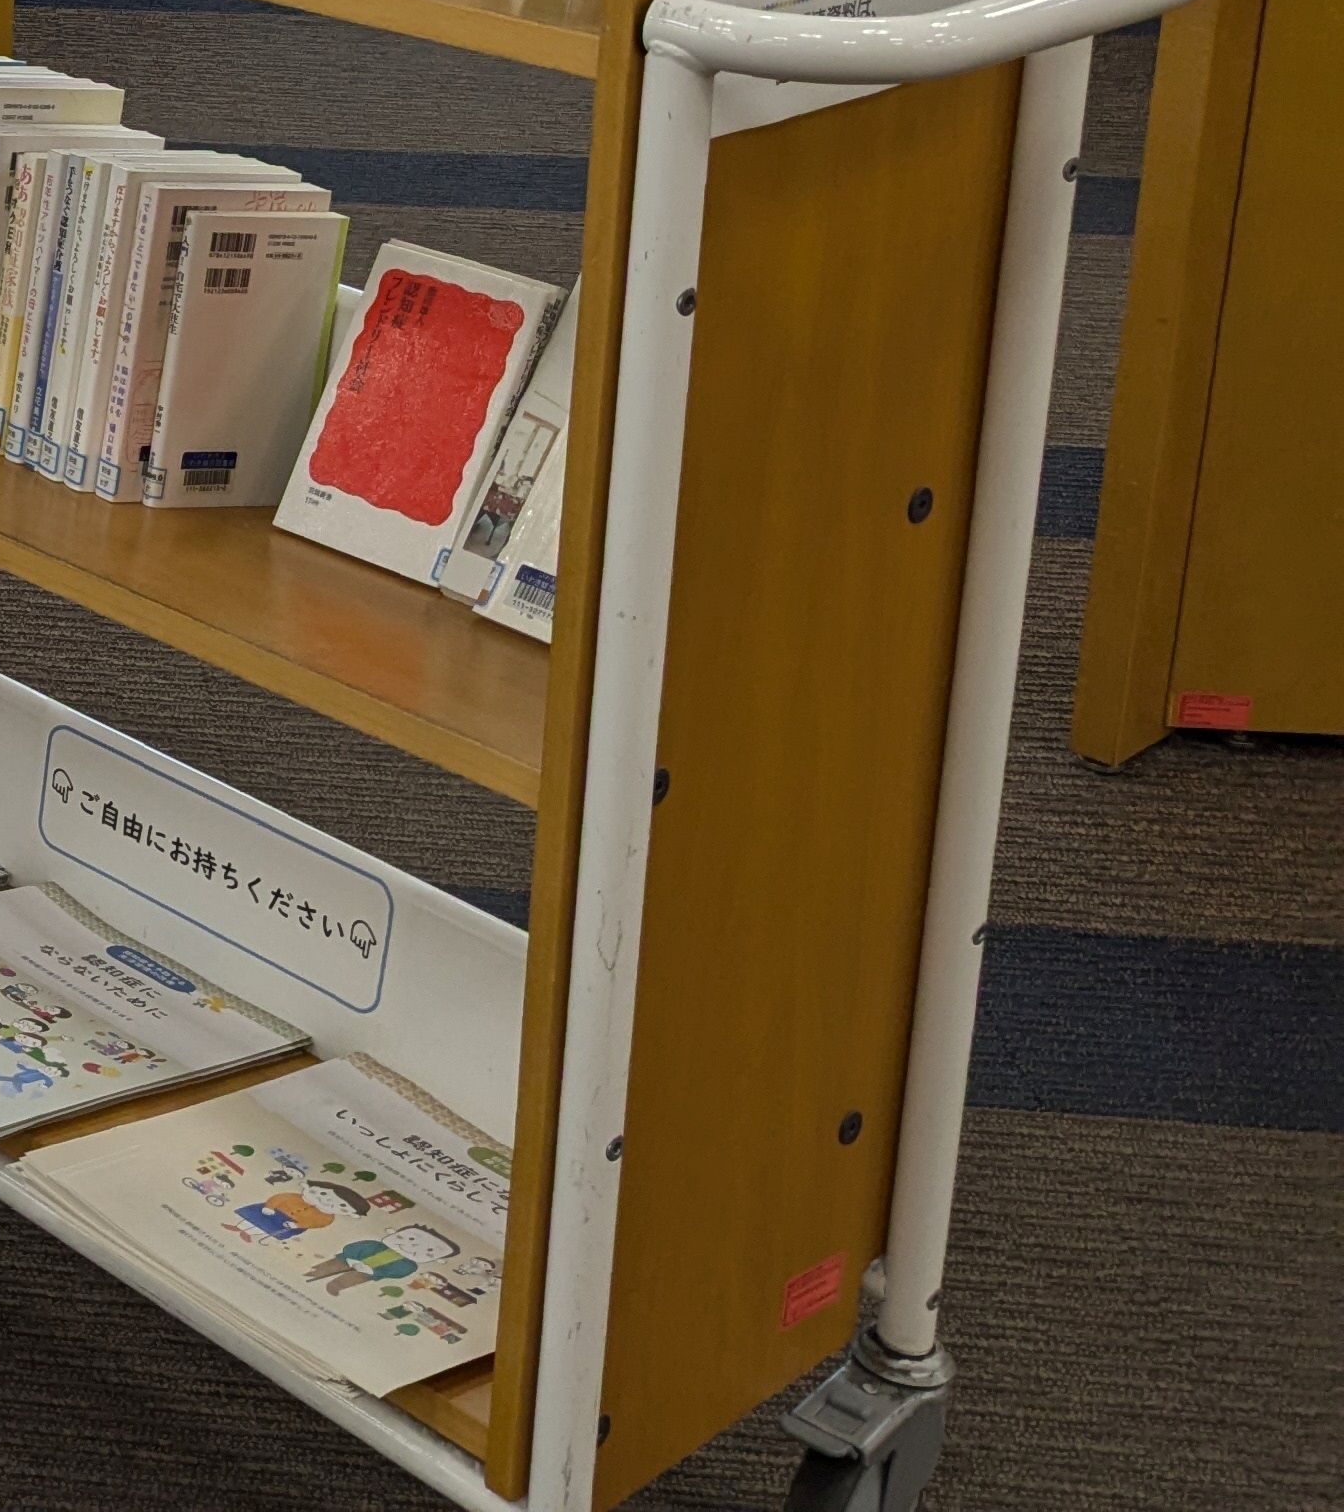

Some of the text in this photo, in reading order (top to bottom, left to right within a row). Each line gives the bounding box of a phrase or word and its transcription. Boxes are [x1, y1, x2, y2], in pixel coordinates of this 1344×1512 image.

[80, 789, 345, 939] ご自由にお持ちください
[40, 944, 168, 1019] ならないために
